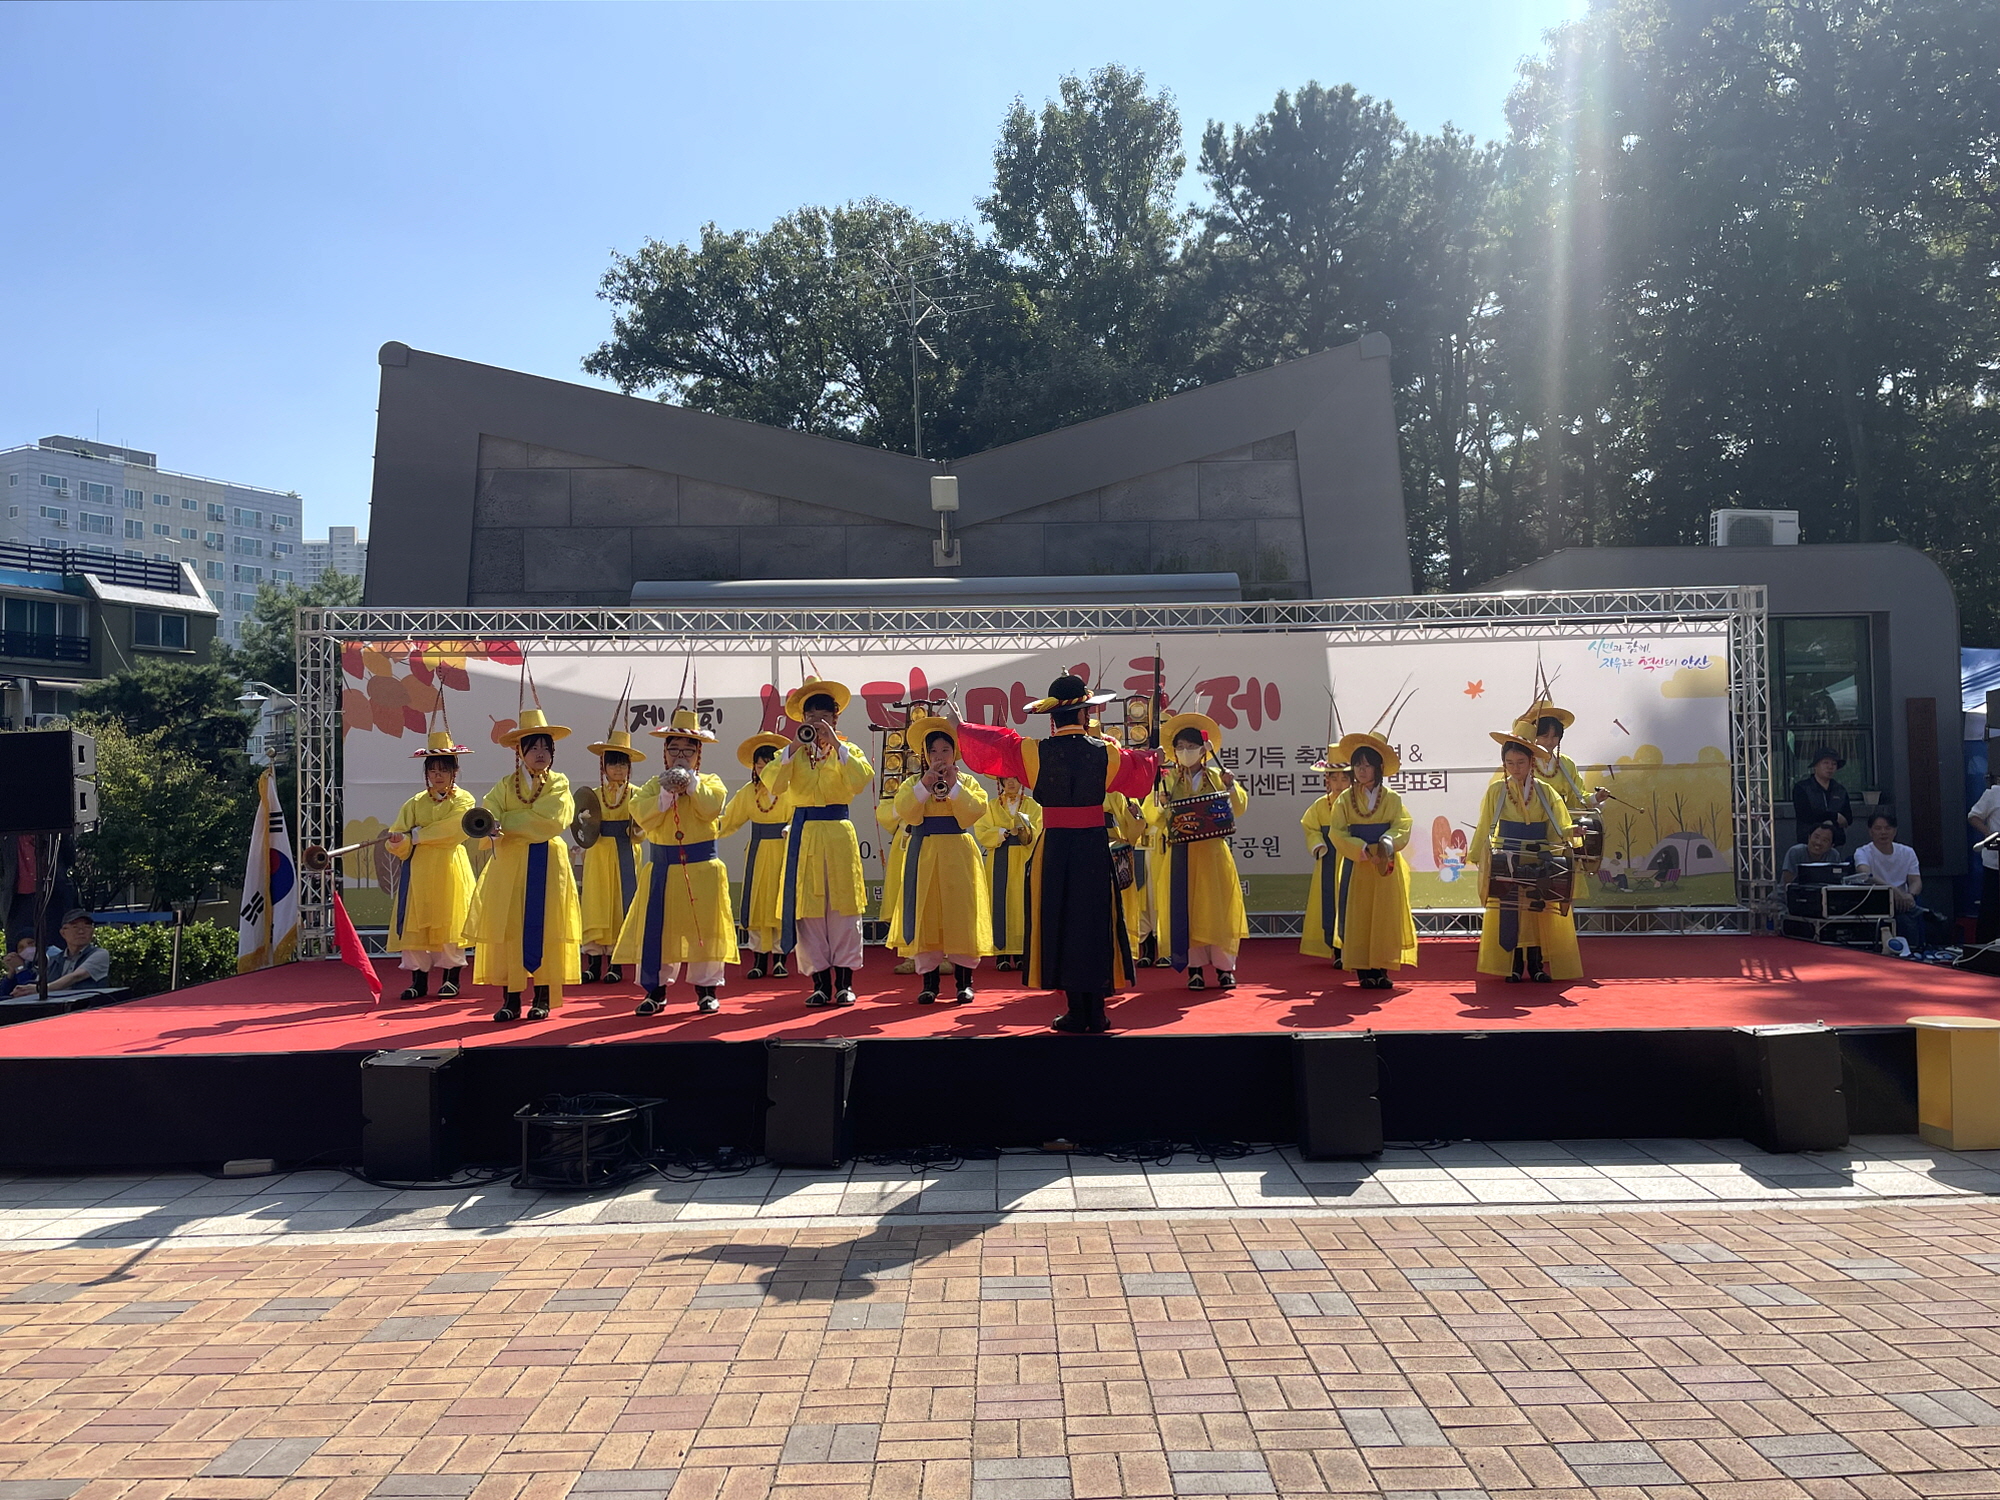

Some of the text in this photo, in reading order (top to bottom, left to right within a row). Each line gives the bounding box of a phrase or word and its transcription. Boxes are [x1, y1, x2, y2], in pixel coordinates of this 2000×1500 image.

[1587, 637, 1624, 659] 시민과
[1599, 655, 1712, 674] 자유로운 혁신도시 안산
[630, 699, 723, 734] 제회
[1245, 746, 1286, 769] 가득
[1409, 744, 1423, 762] &
[1387, 771, 1447, 793] 발표회
